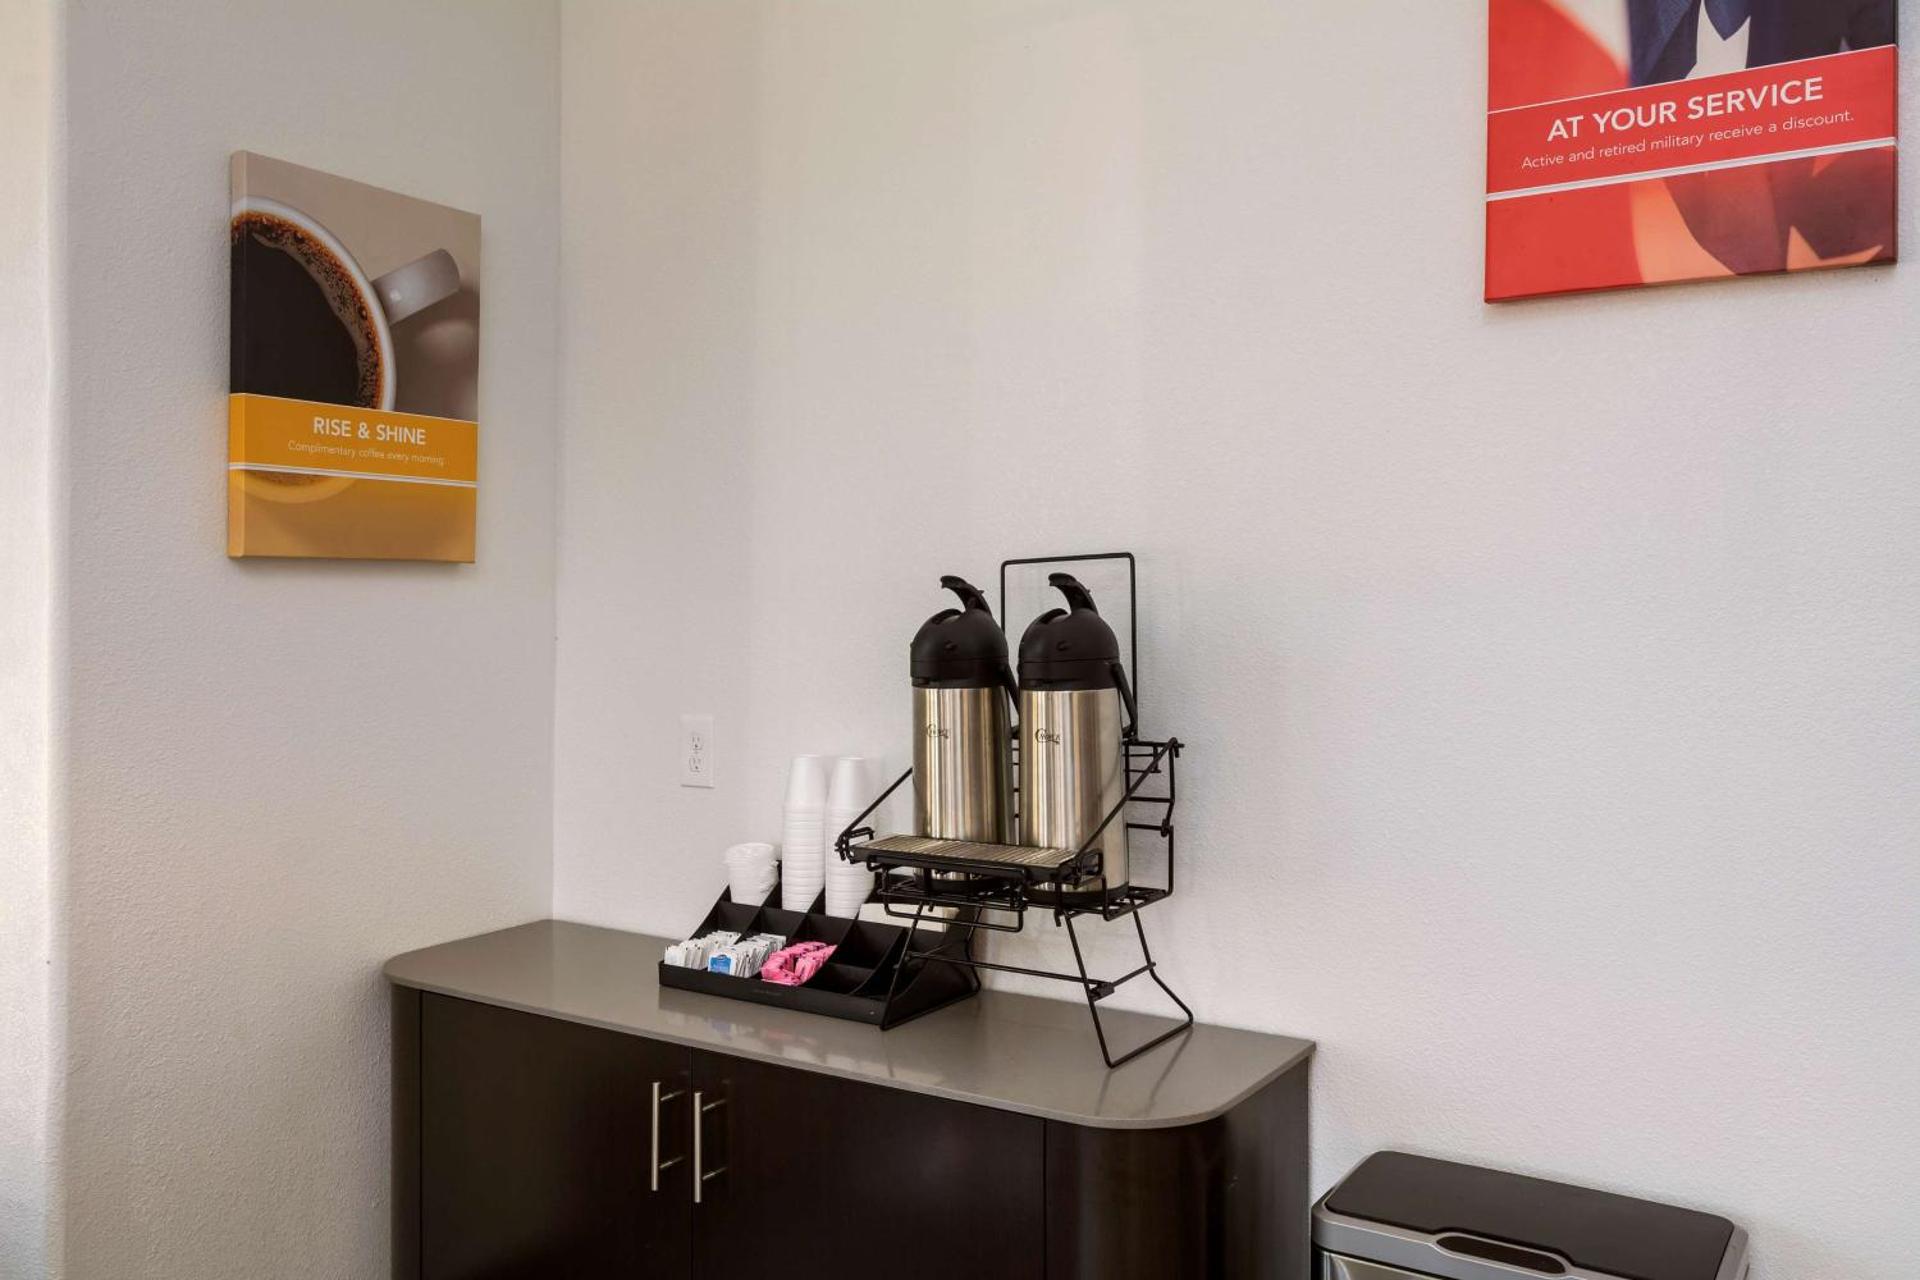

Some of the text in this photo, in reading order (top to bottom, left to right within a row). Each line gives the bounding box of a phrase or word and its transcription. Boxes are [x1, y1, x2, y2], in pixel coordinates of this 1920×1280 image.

[1547, 76, 1824, 142] AT YOUR SERVICE
[1521, 109, 1854, 169] Active and retired military receive a discount.
[287, 439, 356, 459] Complimentary
[359, 447, 385, 459] coffee
[387, 451, 409, 463] every
[313, 416, 427, 445] RISE & SHINE
